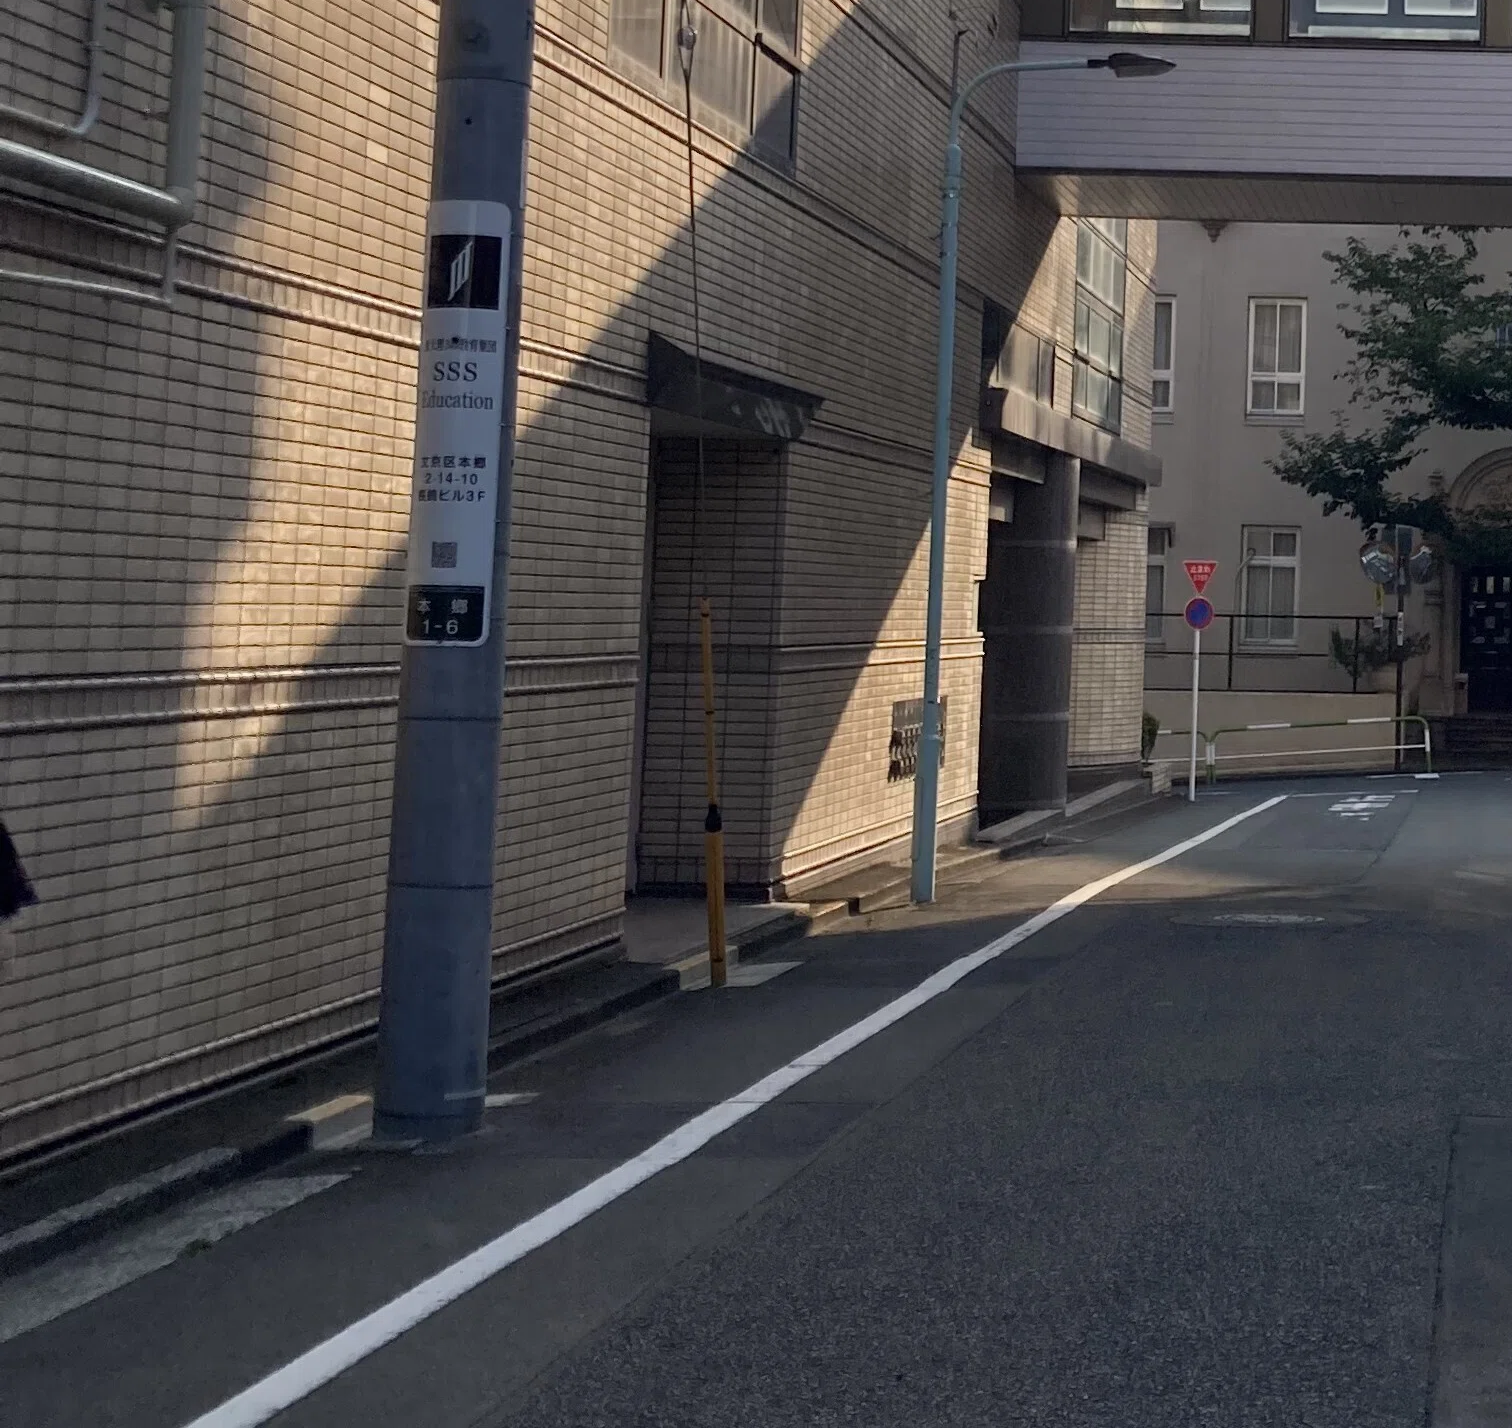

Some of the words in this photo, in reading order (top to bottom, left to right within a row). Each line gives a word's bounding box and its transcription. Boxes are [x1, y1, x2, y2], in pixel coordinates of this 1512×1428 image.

[433, 361, 478, 382] SSS
[422, 389, 494, 410] Education
[424, 472, 478, 485] 2-14-10
[422, 619, 459, 635] 1-6
